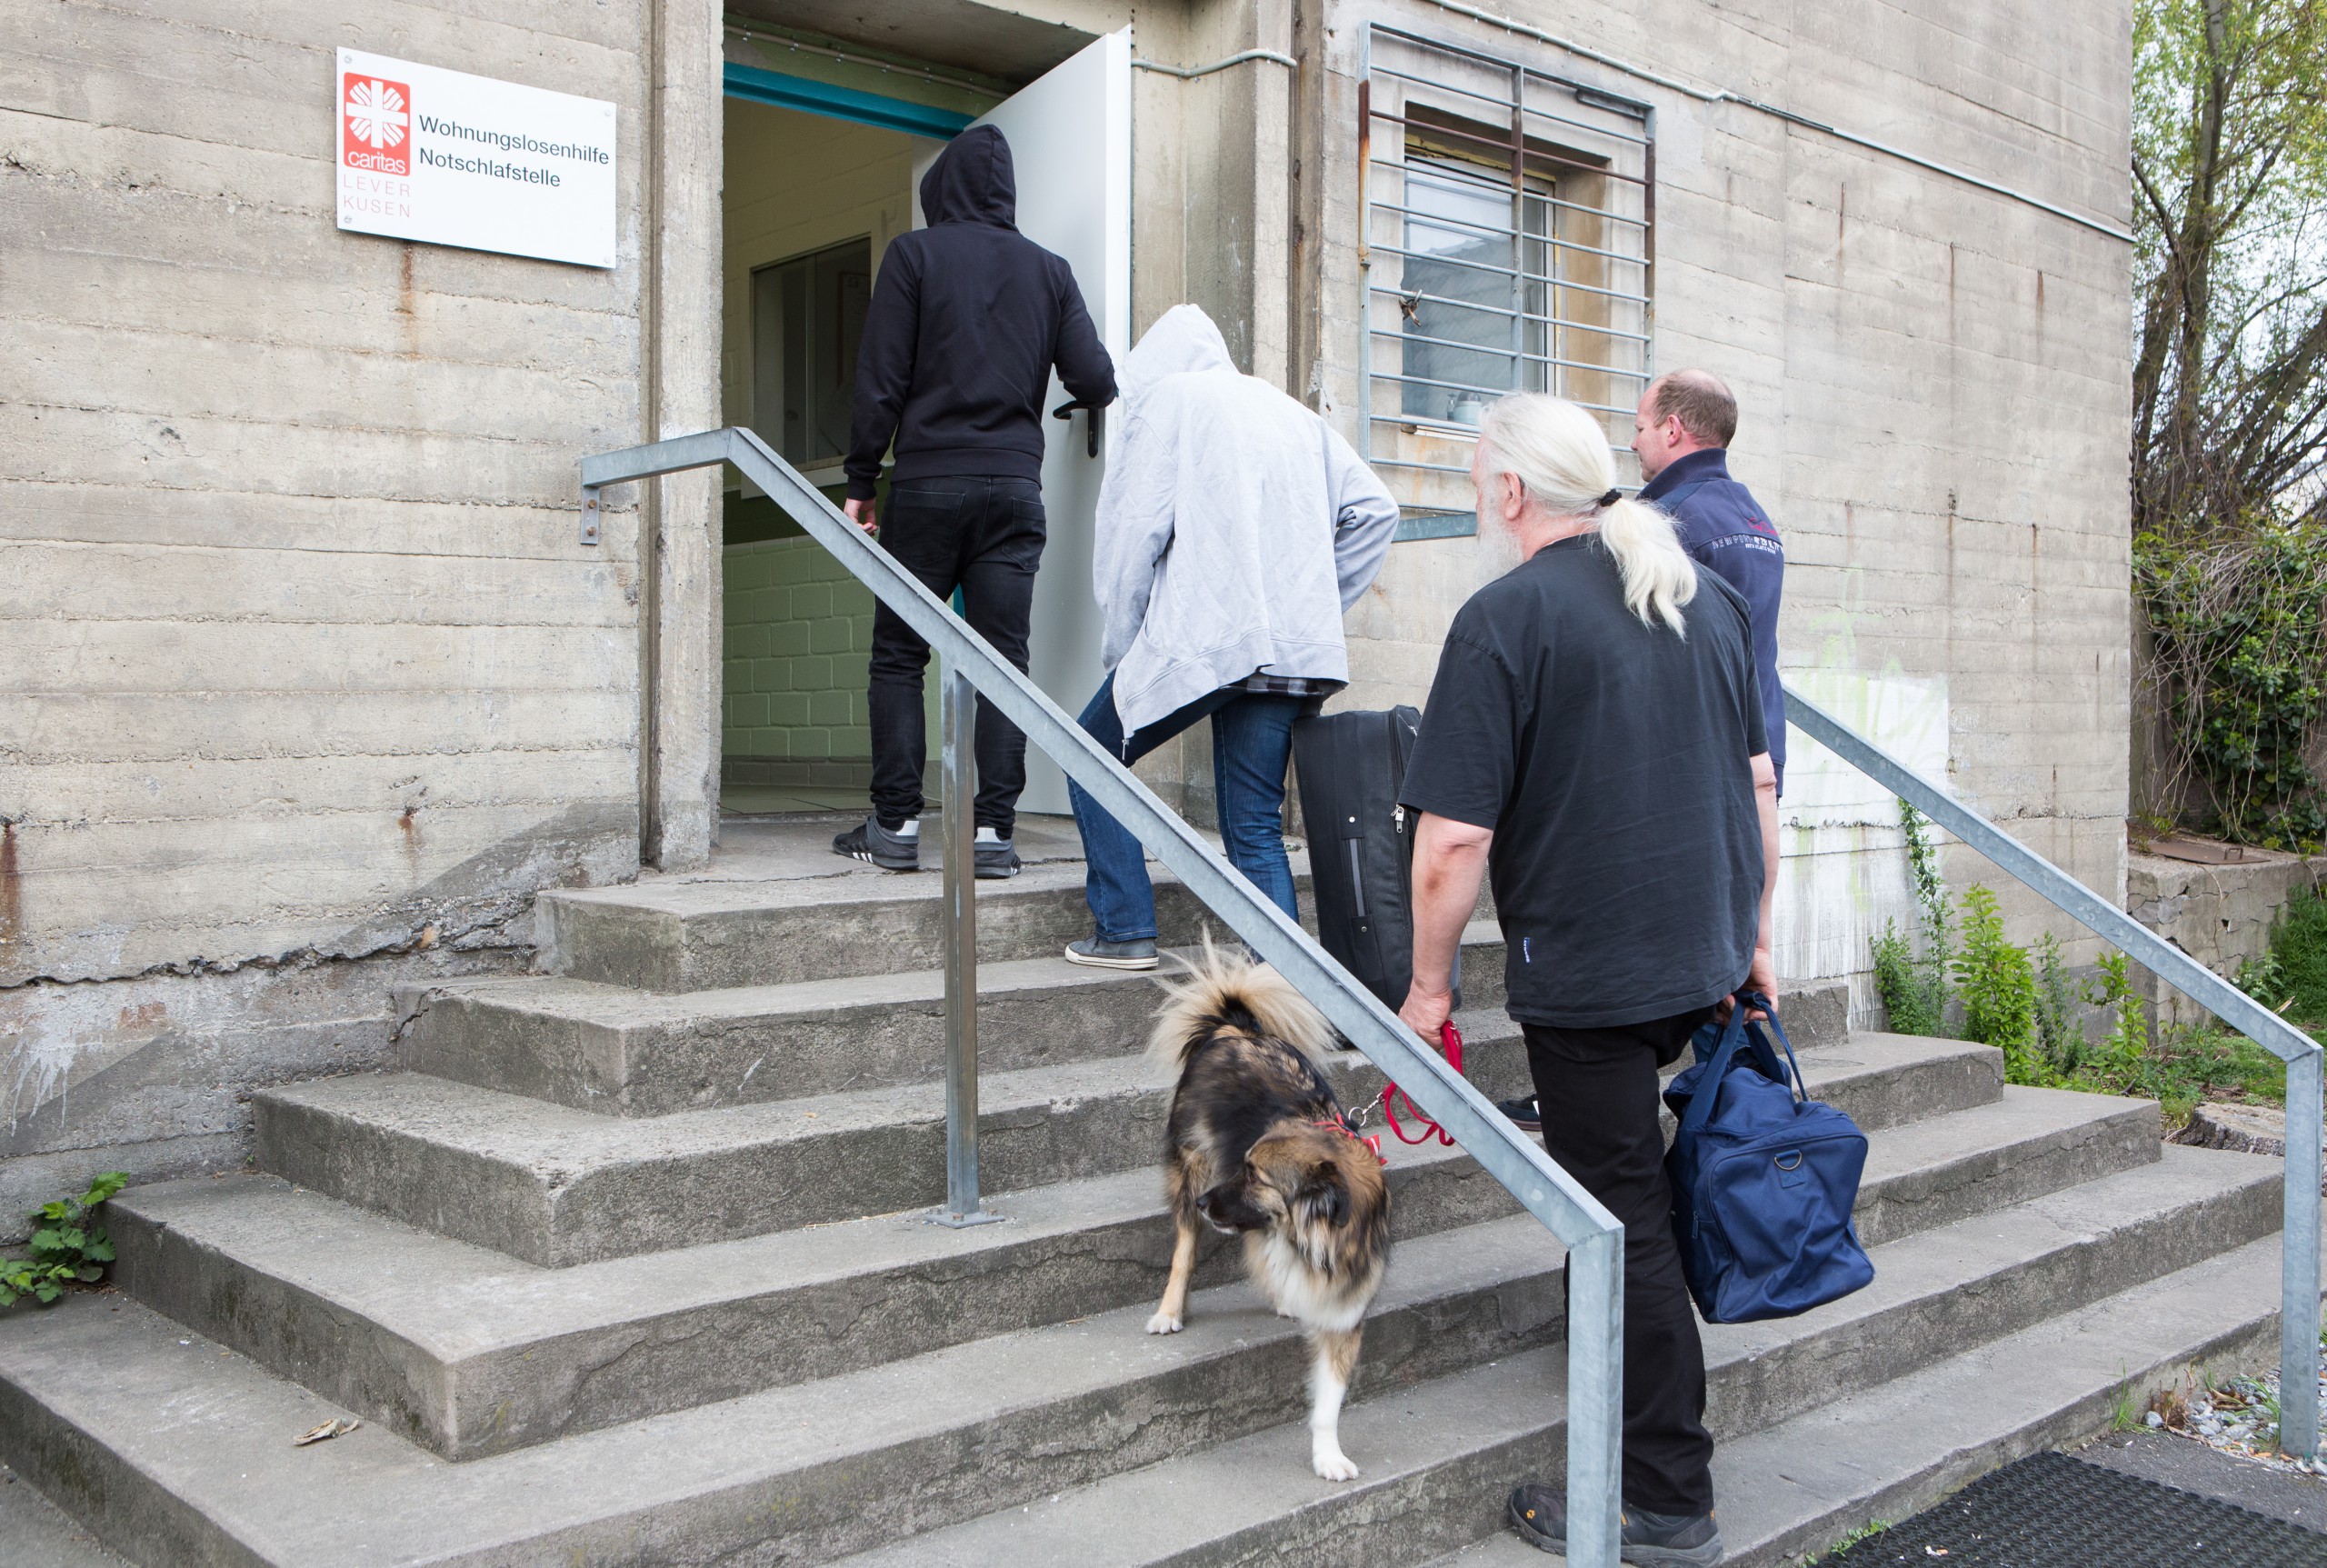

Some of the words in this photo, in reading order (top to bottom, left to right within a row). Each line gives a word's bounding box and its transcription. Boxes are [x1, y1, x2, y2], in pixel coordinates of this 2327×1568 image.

[419, 115, 609, 165] Wohnungslosenhilfe
[347, 150, 406, 175] caritas
[420, 147, 561, 187] Notschlafstelle
[344, 174, 411, 197] LEVER
[344, 195, 411, 218] KUSEN
